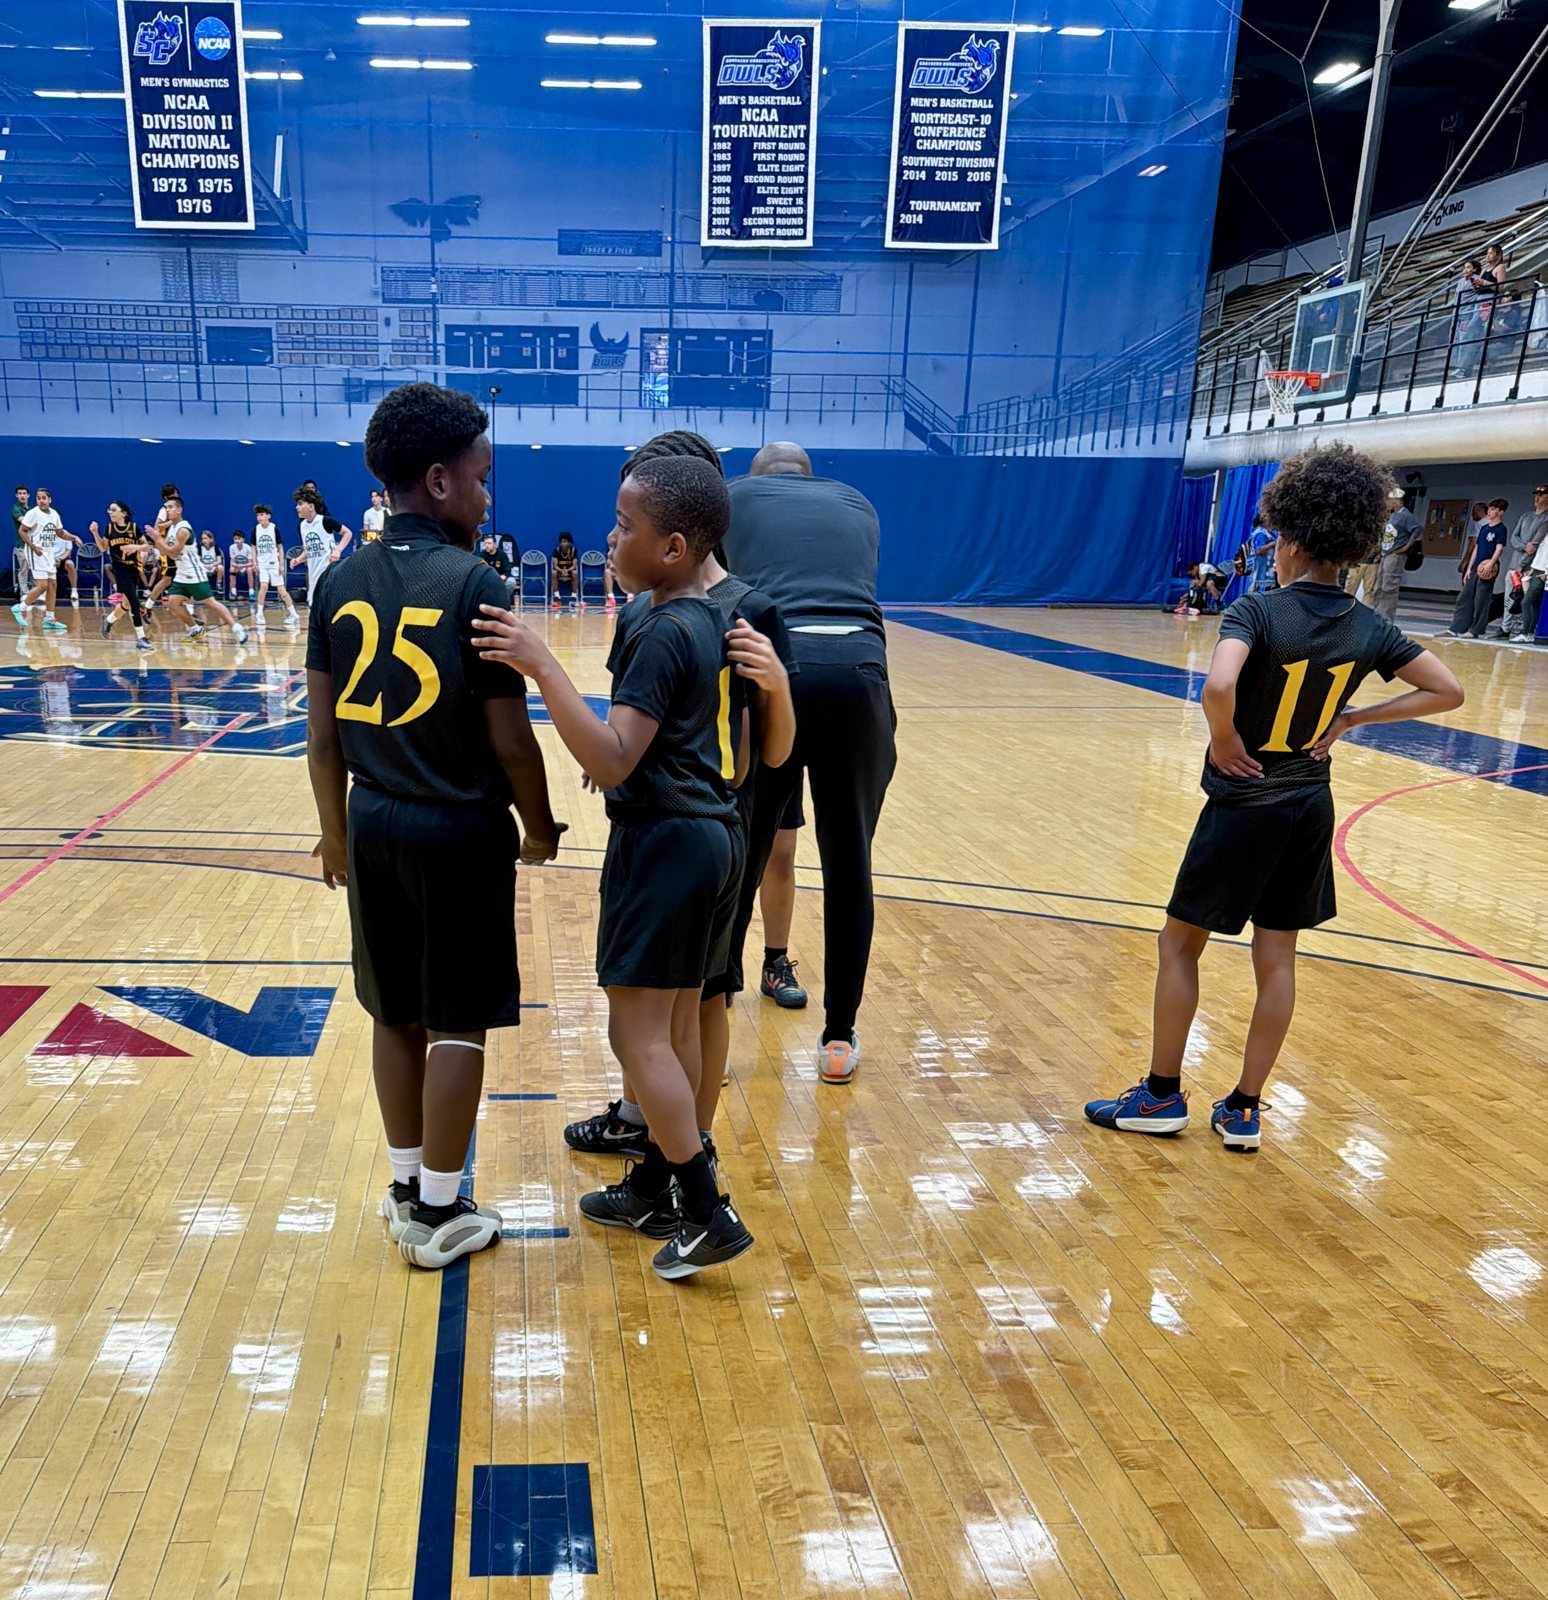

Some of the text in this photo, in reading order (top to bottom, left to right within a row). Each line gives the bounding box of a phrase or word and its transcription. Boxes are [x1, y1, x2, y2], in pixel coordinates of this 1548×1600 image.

[198, 38, 231, 50] NCAA
[720, 64, 779, 82] OWLS
[913, 67, 971, 86] OWLS
[140, 77, 229, 88] MEN'S GYMNASTICS
[163, 94, 210, 110] NCAA
[719, 95, 802, 106] MEN'S BASKETBALL
[910, 97, 994, 109] MEN'S BASKETBALL
[741, 108, 779, 122] NCAA
[911, 112, 992, 125] NORTHEAST-10
[142, 114, 233, 130] DIVISION II
[713, 124, 807, 139] TOURNAMENT
[914, 126, 987, 138] CONFERENCE
[148, 134, 230, 150] NATIONAL
[713, 142, 806, 150] 1982 FIRST ROUND
[916, 139, 982, 151] CHAMPIONS
[141, 153, 240, 169] CHAMPIONS
[713, 153, 805, 161] 1983 FIRST ROUND
[902, 156, 995, 168] SOUTHWEST DIVISION
[713, 164, 804, 172] 1997 ELITE EIGHT
[712, 175, 804, 184] 2000 SECOND ROUND
[902, 170, 991, 182] 2014 2015 2016
[151, 177, 233, 193] 1973 1975
[712, 186, 804, 194] 2014 ELITE EIGHT
[176, 199, 212, 214] 1976
[712, 197, 730, 205] 2015
[766, 197, 794, 205] SWEET
[909, 200, 981, 212] TOURNAMENT
[712, 206, 804, 215] 2016 FIRST ROUND
[712, 217, 804, 226] 2017 SECOND ROUND
[900, 214, 923, 225] 2014
[712, 228, 804, 236] 2024 FIRST ROUND
[331, 600, 443, 728] 25
[1257, 659, 1356, 753] 11
